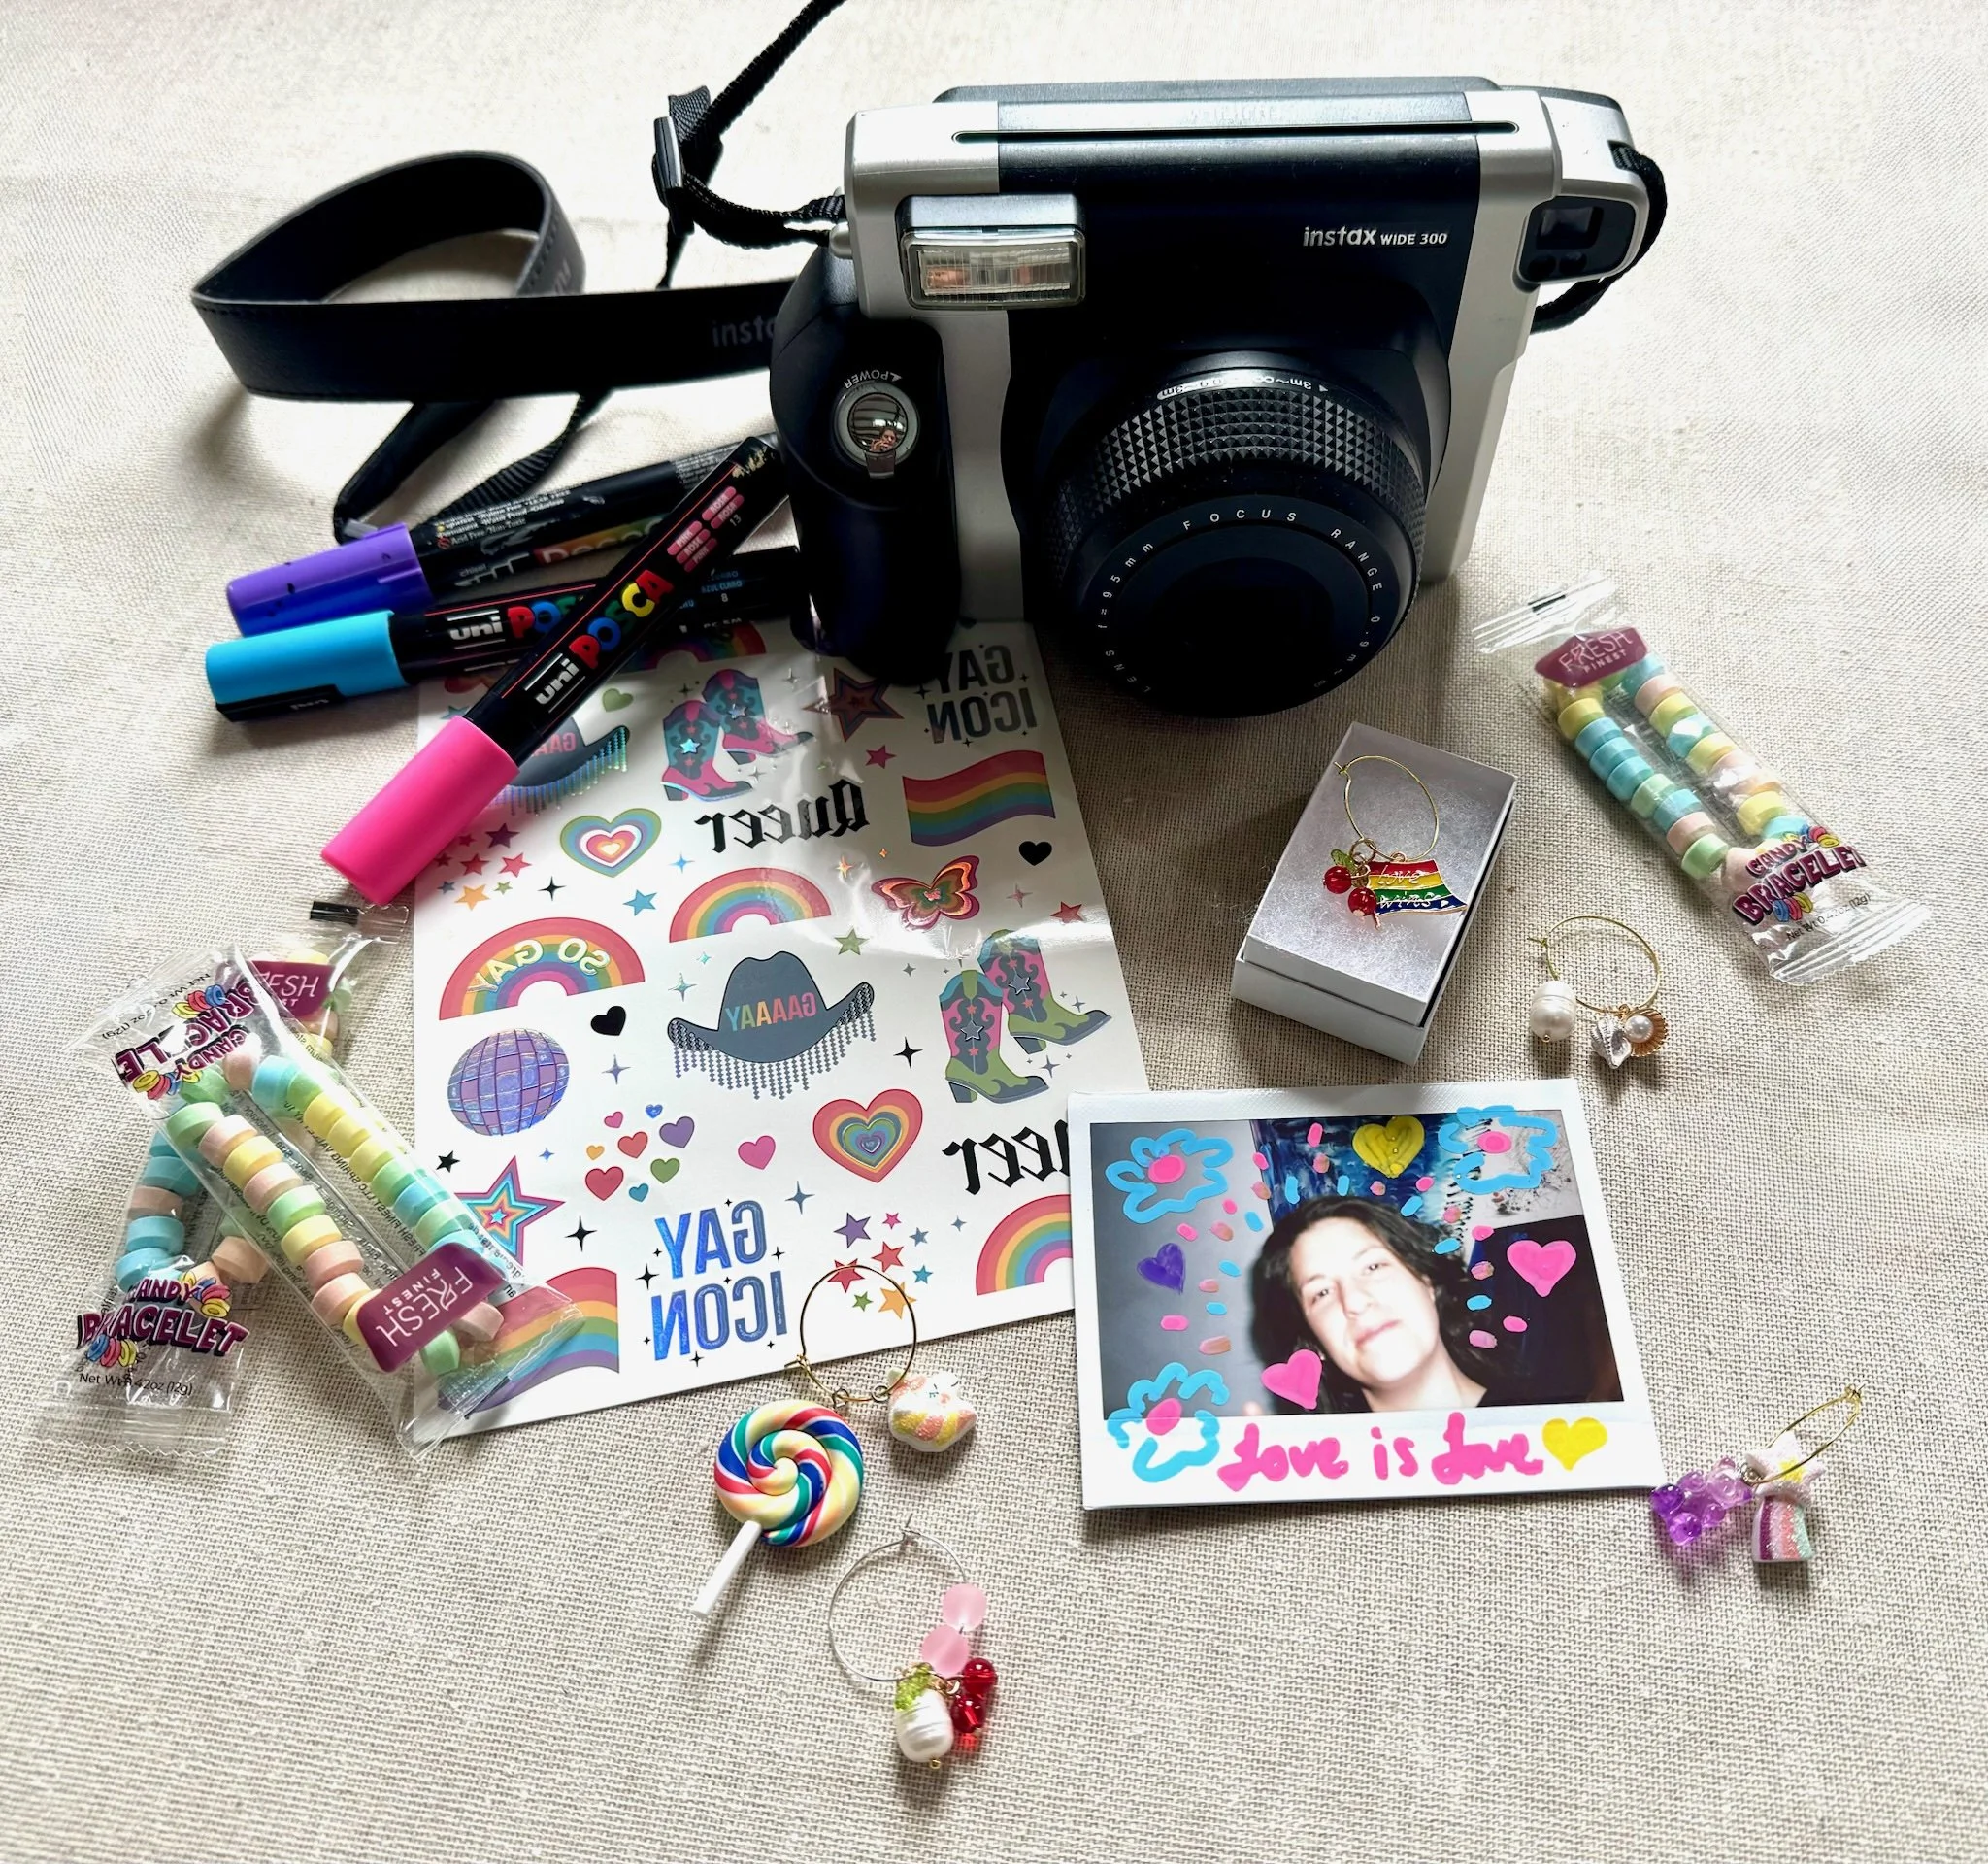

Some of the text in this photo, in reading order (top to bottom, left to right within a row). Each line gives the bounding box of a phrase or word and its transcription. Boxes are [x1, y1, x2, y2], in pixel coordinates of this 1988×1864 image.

[1303, 225, 1448, 247] instax WIDE 300
[712, 314, 775, 348] inst
[843, 369, 889, 389] POWER
[729, 513, 742, 527] 13
[1182, 508, 1298, 531] FOCUS
[1331, 527, 1384, 592] RANGE
[449, 614, 504, 641] uni
[535, 657, 580, 705] uni
[569, 569, 675, 670] POSCA
[1558, 631, 1634, 672] FRESH
[1745, 835, 1807, 878] CANDY
[175, 1024, 250, 1081] CANDY
[376, 1266, 473, 1347] FRESH
[382, 1268, 441, 1315] FINEST
[79, 1373, 101, 1384] Net
[166, 1381, 193, 1397] (12g)
[1372, 1426, 1416, 1480] is
